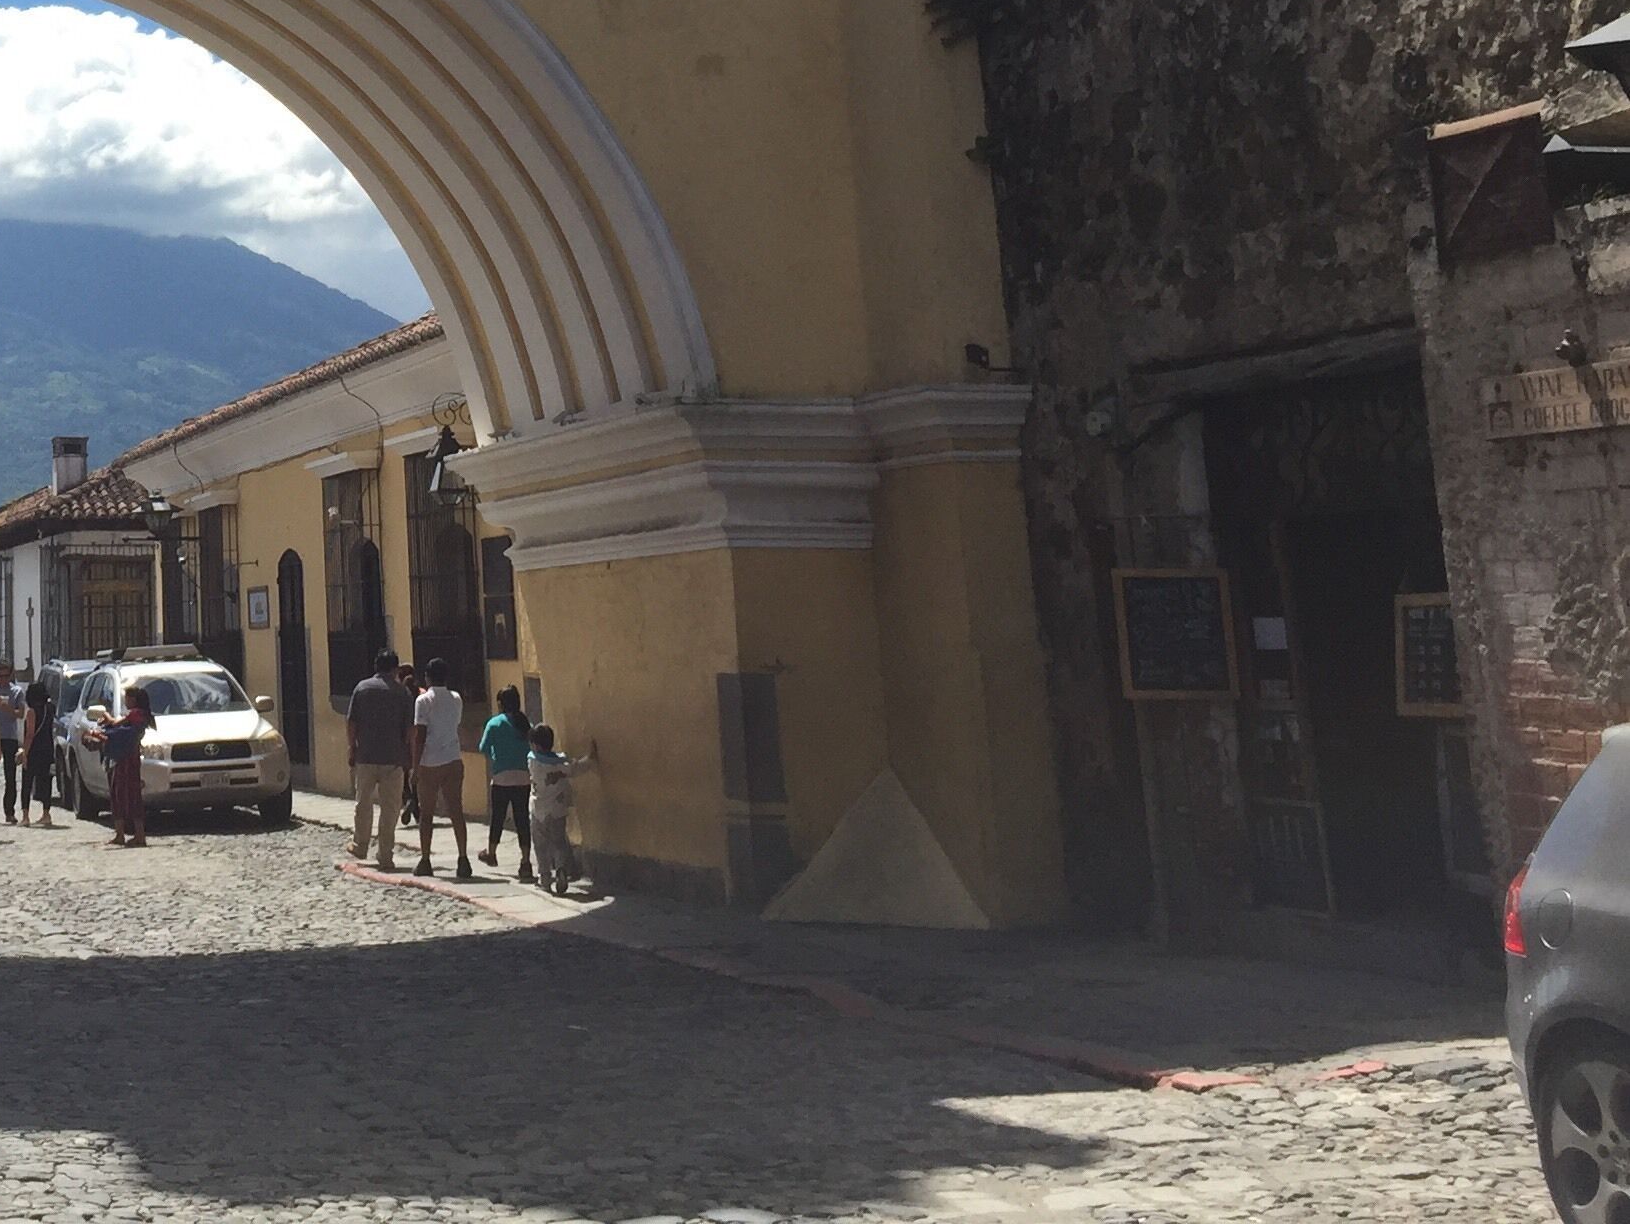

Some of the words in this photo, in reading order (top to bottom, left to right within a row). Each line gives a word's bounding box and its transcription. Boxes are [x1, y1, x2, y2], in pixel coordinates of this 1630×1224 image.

[1520, 373, 1563, 400] WINE
[1576, 365, 1630, 392] HABA
[1523, 403, 1581, 427] COFFEE
